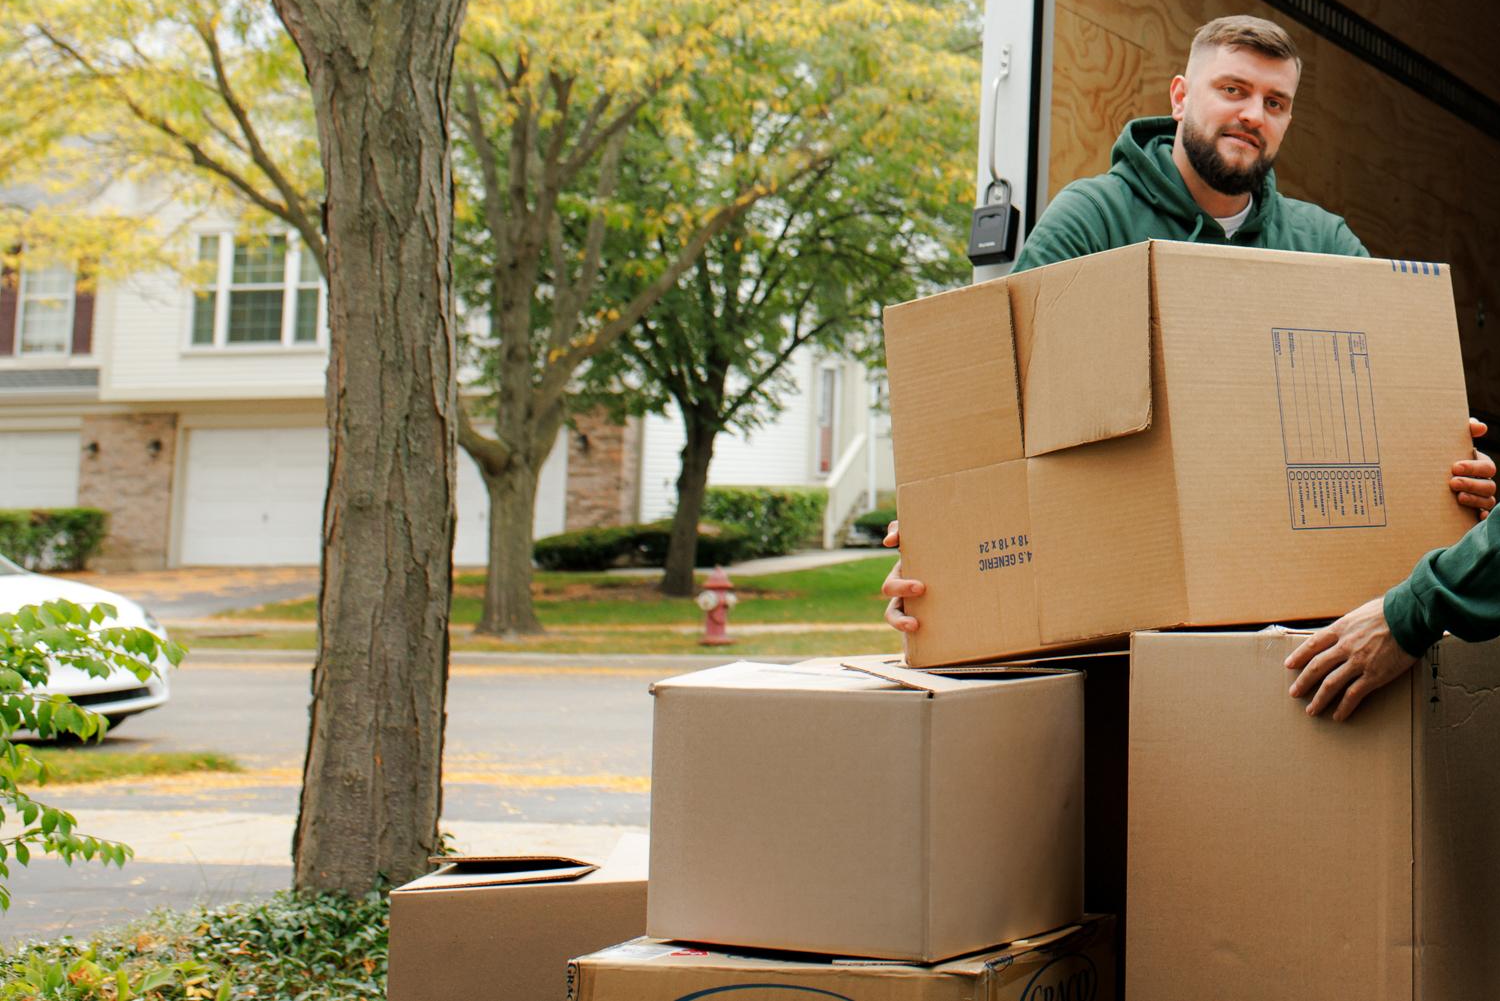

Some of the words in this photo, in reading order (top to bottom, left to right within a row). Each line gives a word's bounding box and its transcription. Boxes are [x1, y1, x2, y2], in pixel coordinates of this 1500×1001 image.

[991, 541, 997, 550] x
[998, 538, 1009, 551] 18
[1010, 536, 1016, 546] x
[1017, 534, 1029, 547] 18
[979, 541, 990, 554] 24
[978, 554, 1017, 572] GENERIC
[1018, 551, 1033, 563] 4.5
